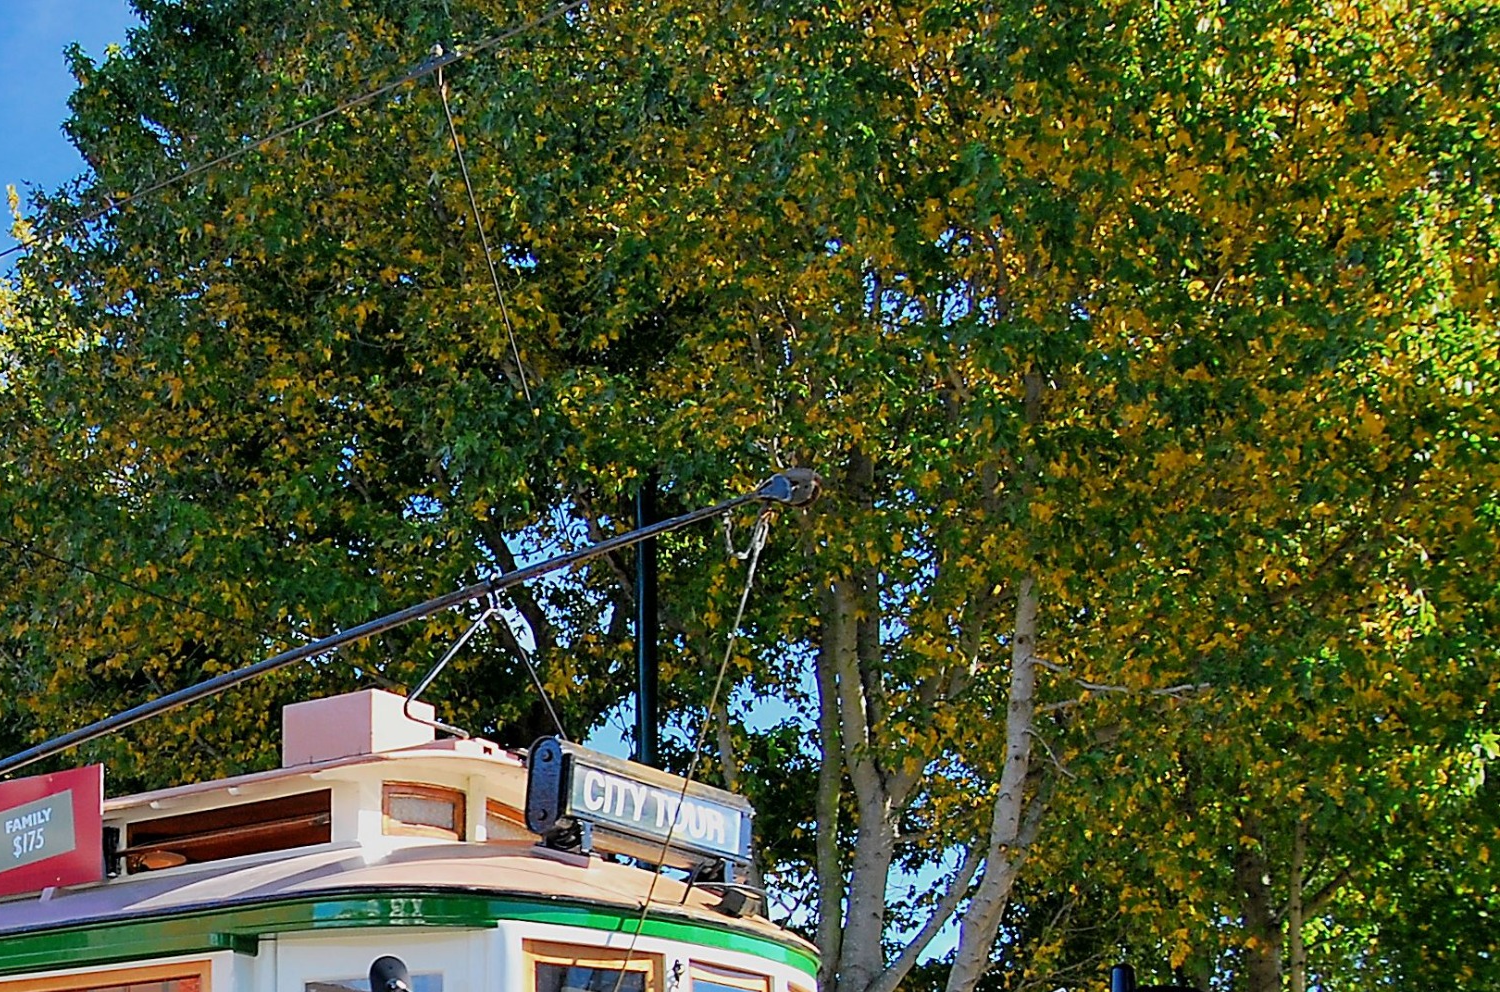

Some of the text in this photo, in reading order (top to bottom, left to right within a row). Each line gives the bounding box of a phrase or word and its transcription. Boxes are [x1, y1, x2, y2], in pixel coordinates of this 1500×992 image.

[5, 808, 52, 834] FAMILY
[584, 771, 725, 844] CITY TOUR
[13, 828, 44, 858] $175
